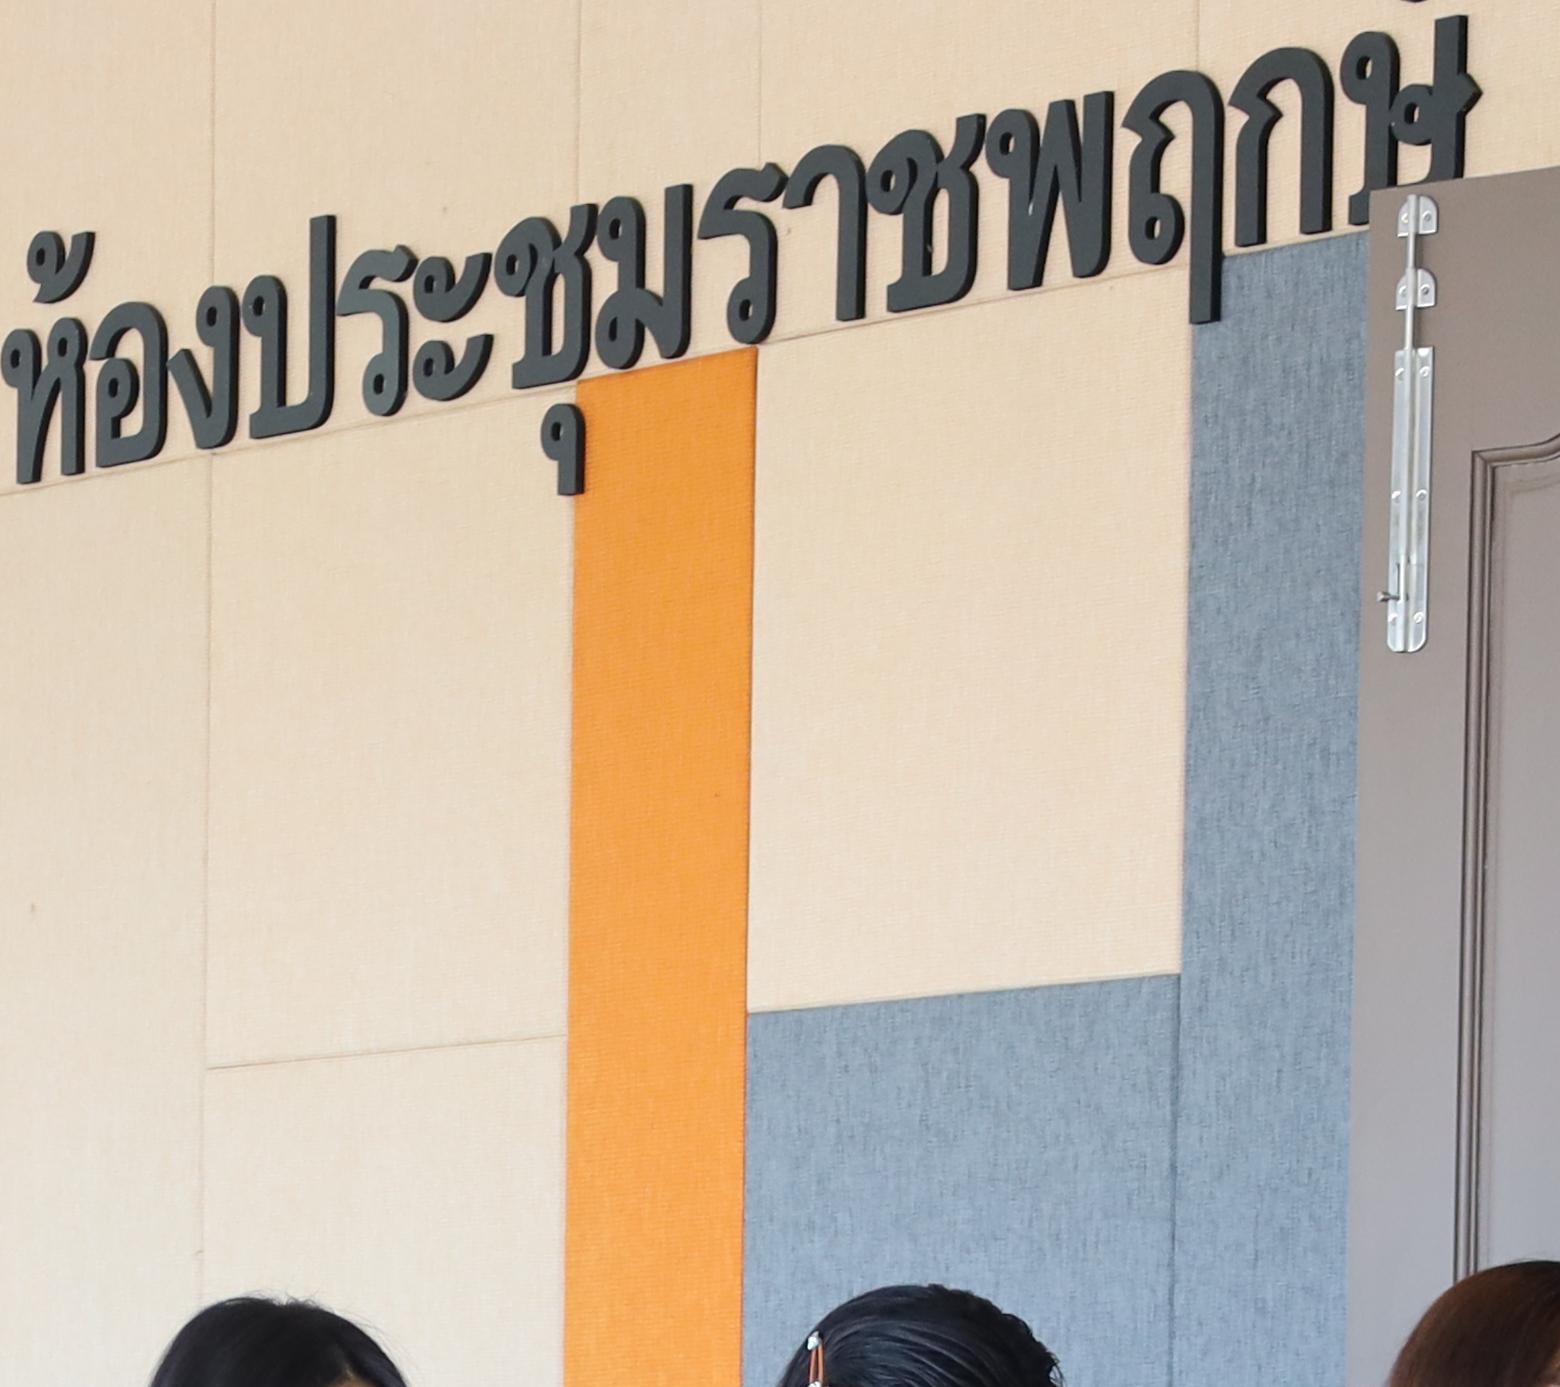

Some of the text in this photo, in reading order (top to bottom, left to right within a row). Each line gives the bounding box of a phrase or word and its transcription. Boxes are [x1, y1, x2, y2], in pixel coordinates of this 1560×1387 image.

[0, 0, 1484, 498] ห้องประชุมราชพฤกษ
